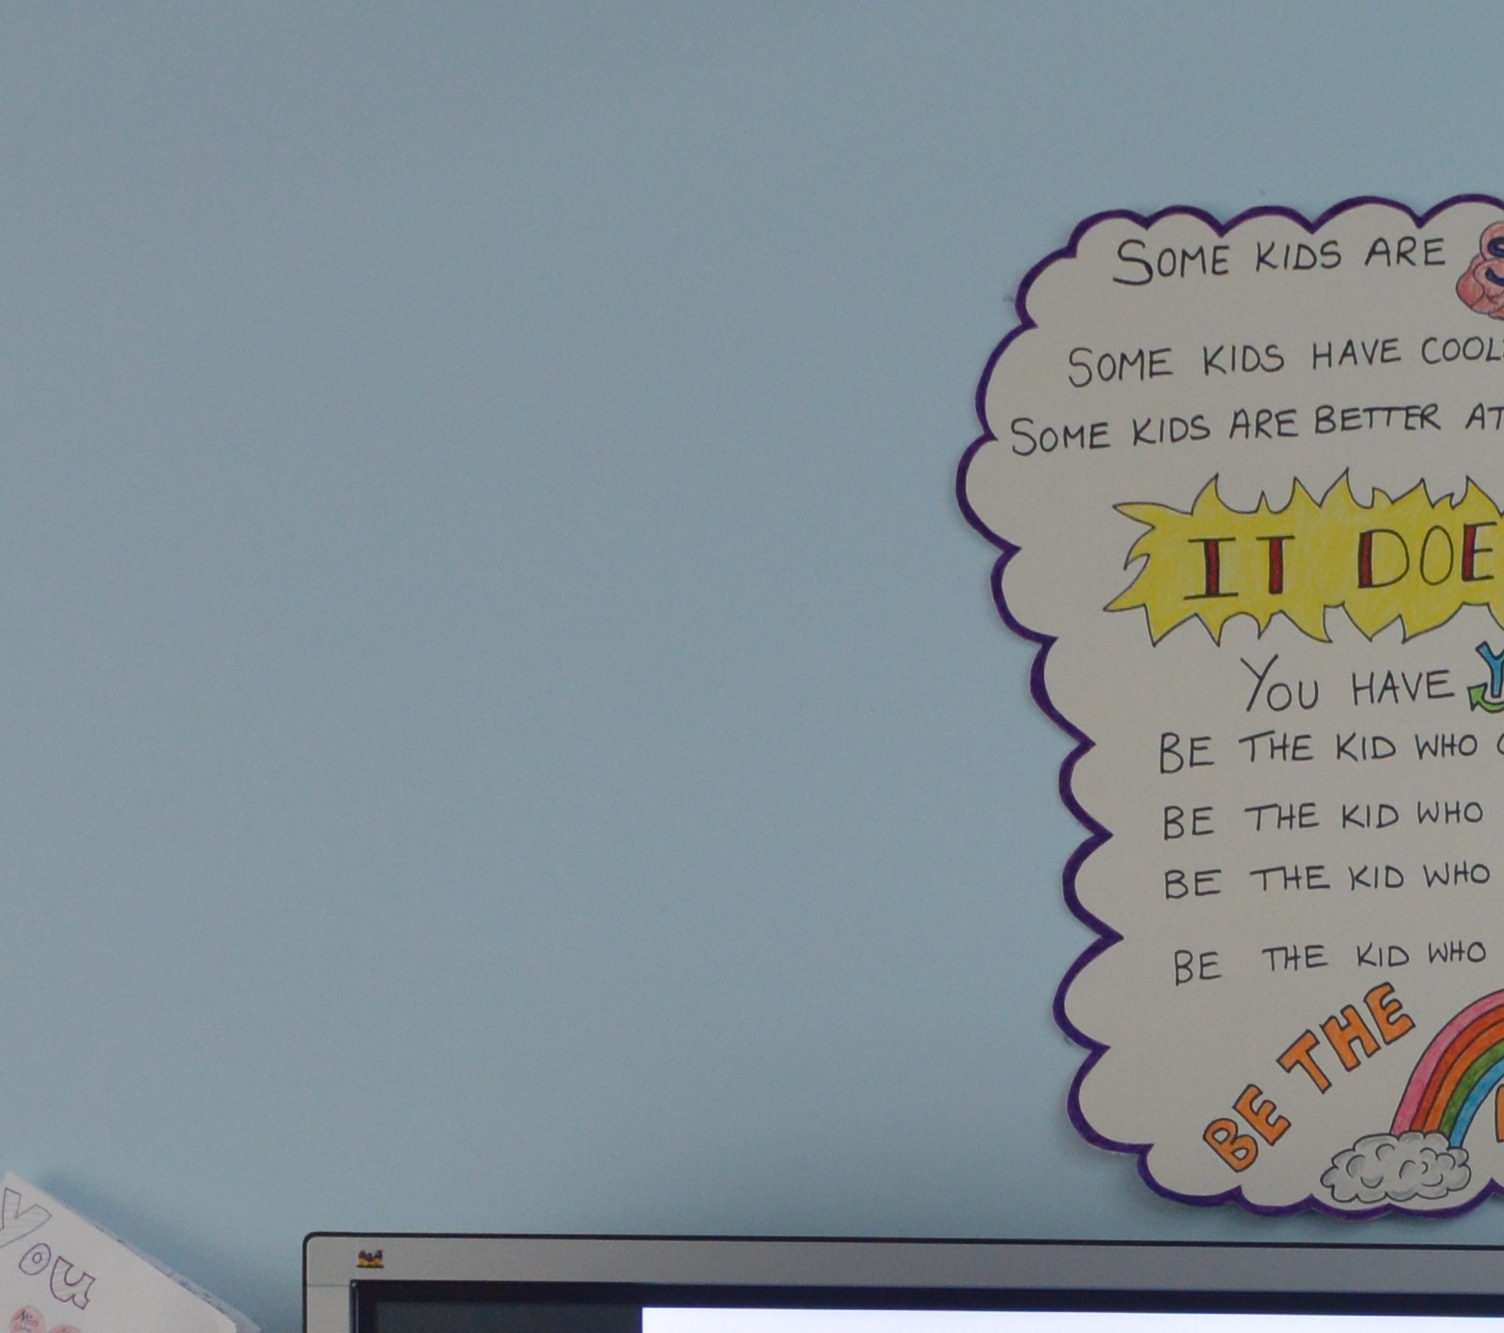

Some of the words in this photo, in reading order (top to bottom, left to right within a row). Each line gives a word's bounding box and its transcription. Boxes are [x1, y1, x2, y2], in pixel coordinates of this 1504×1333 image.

[1112, 238, 1230, 287] SOME
[1255, 236, 1343, 273] KIDS
[1364, 232, 1448, 269] ARE
[1068, 343, 1174, 389] SOME
[1202, 337, 1288, 377] KIDS
[1311, 333, 1405, 370] HAVE
[1009, 414, 1115, 454] SOME
[1131, 411, 1212, 448] KIDS
[1227, 404, 1299, 441] ARE
[1312, 401, 1441, 437] BETTER
[1182, 534, 1298, 600] IT
[1240, 654, 1322, 718] YOU
[1351, 665, 1457, 707] HAVE
[1157, 731, 1215, 774] BE
[1238, 730, 1316, 765] THE
[1335, 728, 1397, 763] KID
[1414, 730, 1480, 762] WHO
[1163, 863, 1222, 902] BE
[1249, 861, 1333, 895] THE
[1349, 859, 1405, 893] KID
[1423, 859, 1491, 892] WHO
[1204, 1082, 1293, 1175] BE
[1278, 982, 1419, 1091] THE
